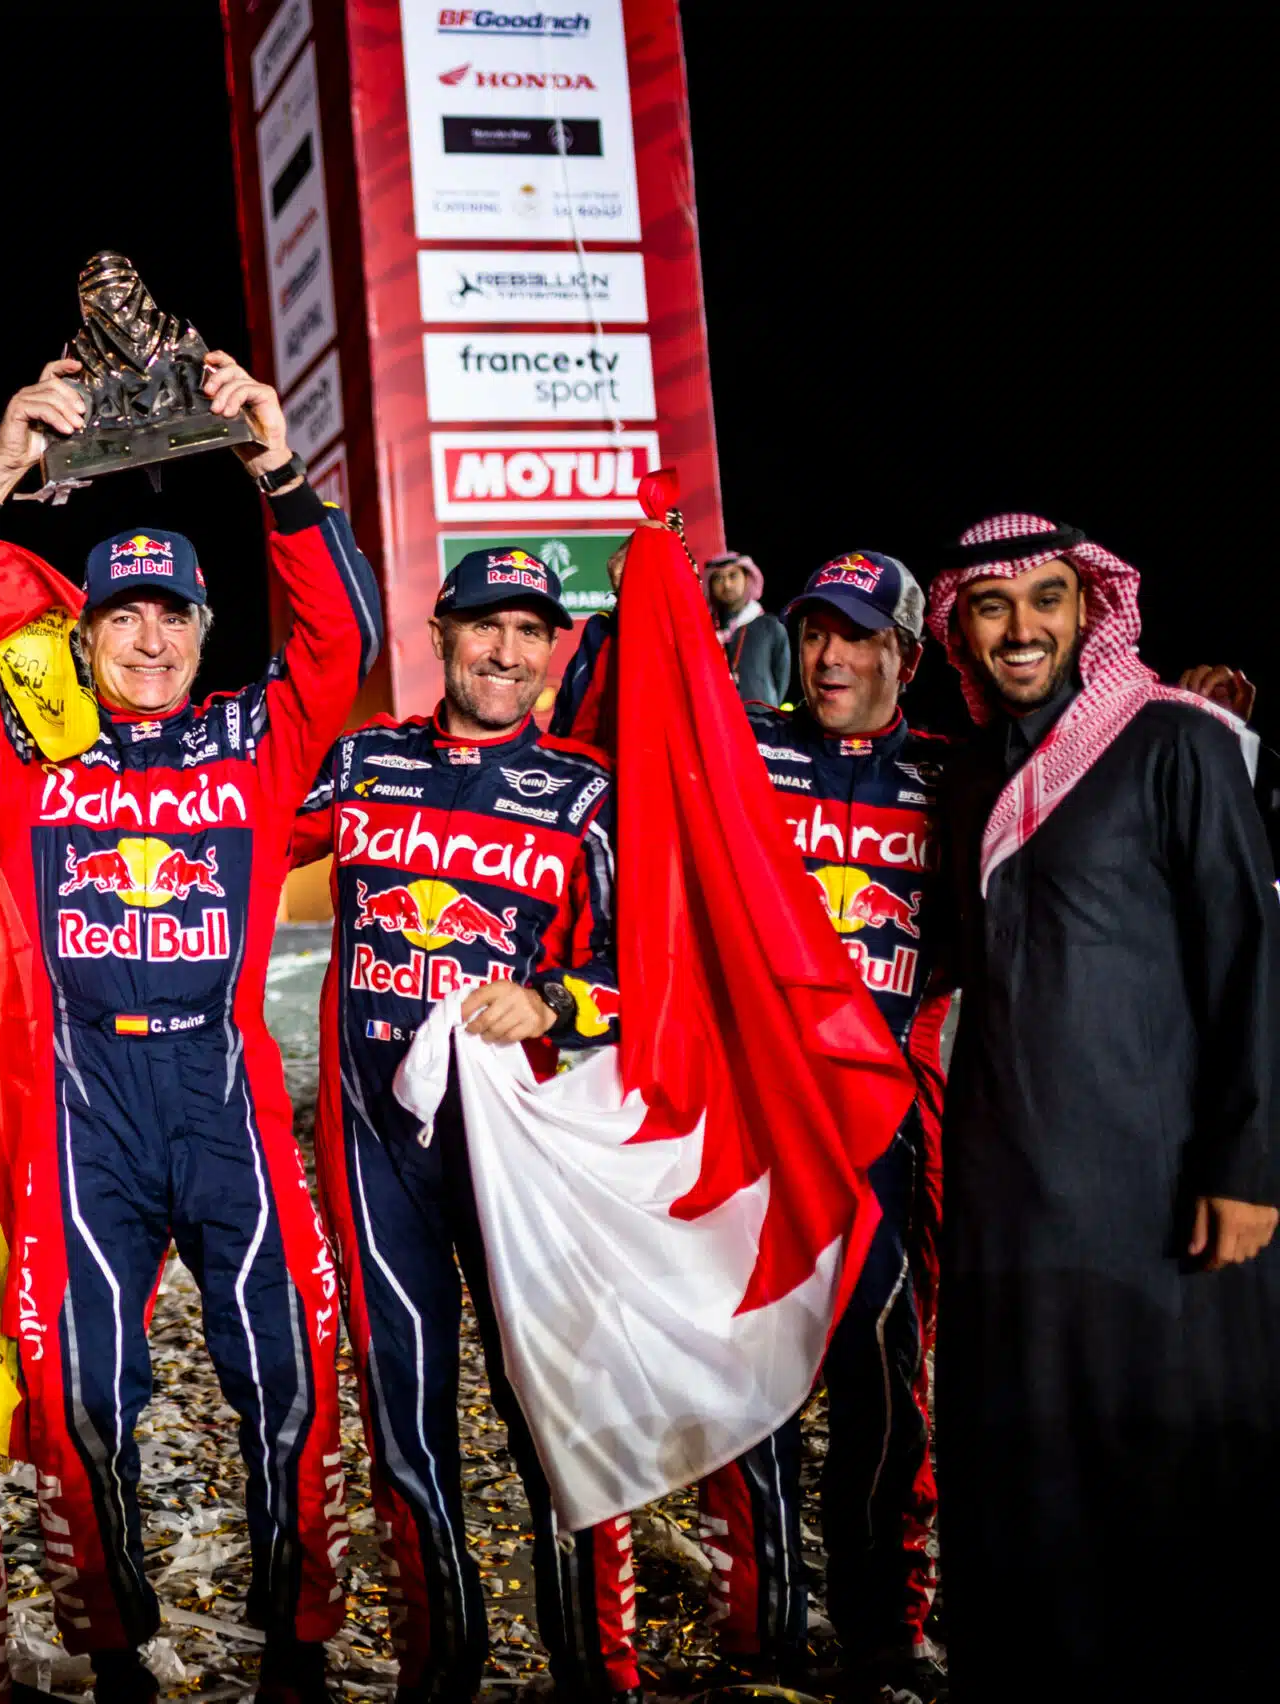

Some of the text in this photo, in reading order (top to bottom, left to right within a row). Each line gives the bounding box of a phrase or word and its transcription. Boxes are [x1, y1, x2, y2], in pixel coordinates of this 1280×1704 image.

[475, 71, 597, 91] HONDA
[535, 376, 620, 408] sport
[454, 450, 642, 499] MOTUL
[110, 558, 174, 580] Red Bull
[487, 570, 548, 593] Red Bull
[843, 571, 877, 593] Bull
[79, 749, 120, 772] RIMAX
[379, 757, 415, 770] WORKS
[371, 784, 425, 799] PRIMAX
[520, 777, 547, 789] MINI
[39, 764, 248, 828] Bahrain
[338, 806, 565, 898] Bahrain
[58, 908, 231, 962] Red Bull
[350, 943, 426, 1000] Red
[150, 1013, 206, 1034] C. Sainz
[393, 1027, 406, 1041] S.
